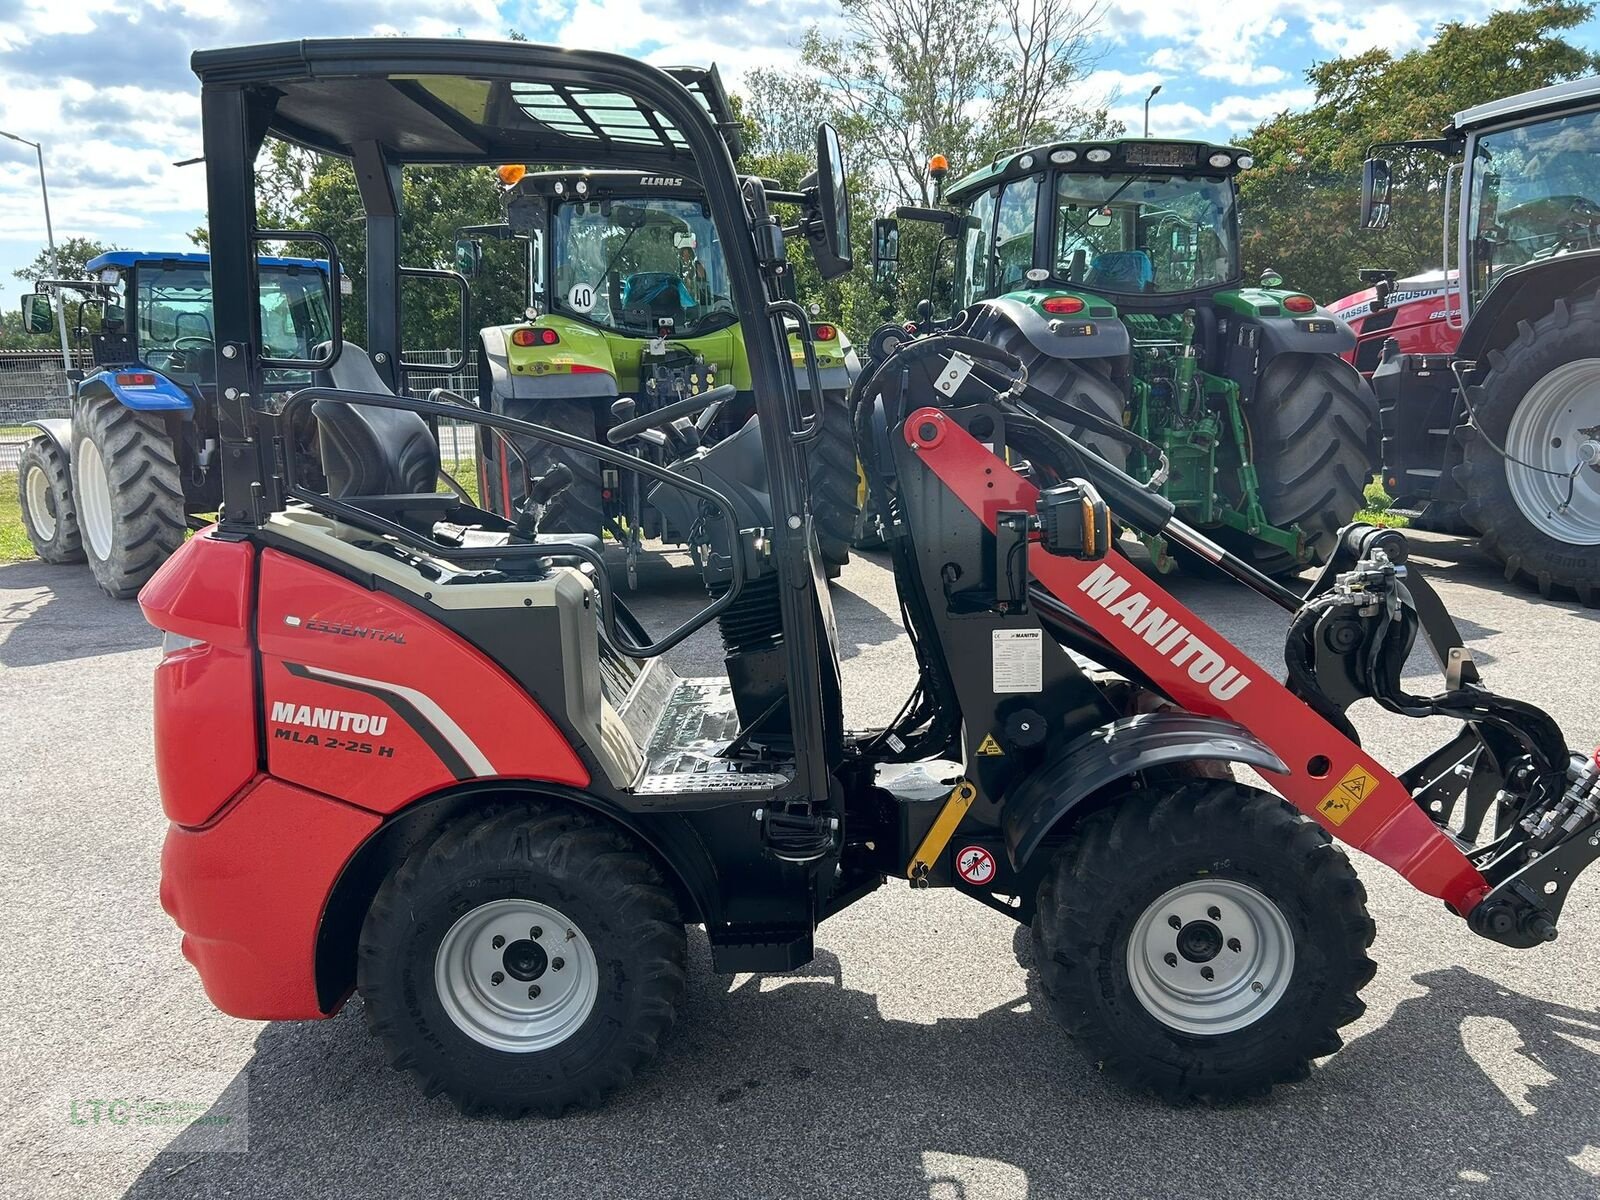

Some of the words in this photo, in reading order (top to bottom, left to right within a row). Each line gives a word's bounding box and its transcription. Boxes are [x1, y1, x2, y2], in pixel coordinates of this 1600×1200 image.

[640, 177, 683, 187] CLAAS
[574, 288, 591, 307] 40
[306, 619, 407, 644] ESSENTIAL
[1077, 562, 1252, 701] MANITOU
[270, 701, 388, 736] MANITOU
[274, 728, 319, 746] MLA
[324, 737, 373, 754] 2-25
[378, 745, 395, 758] H
